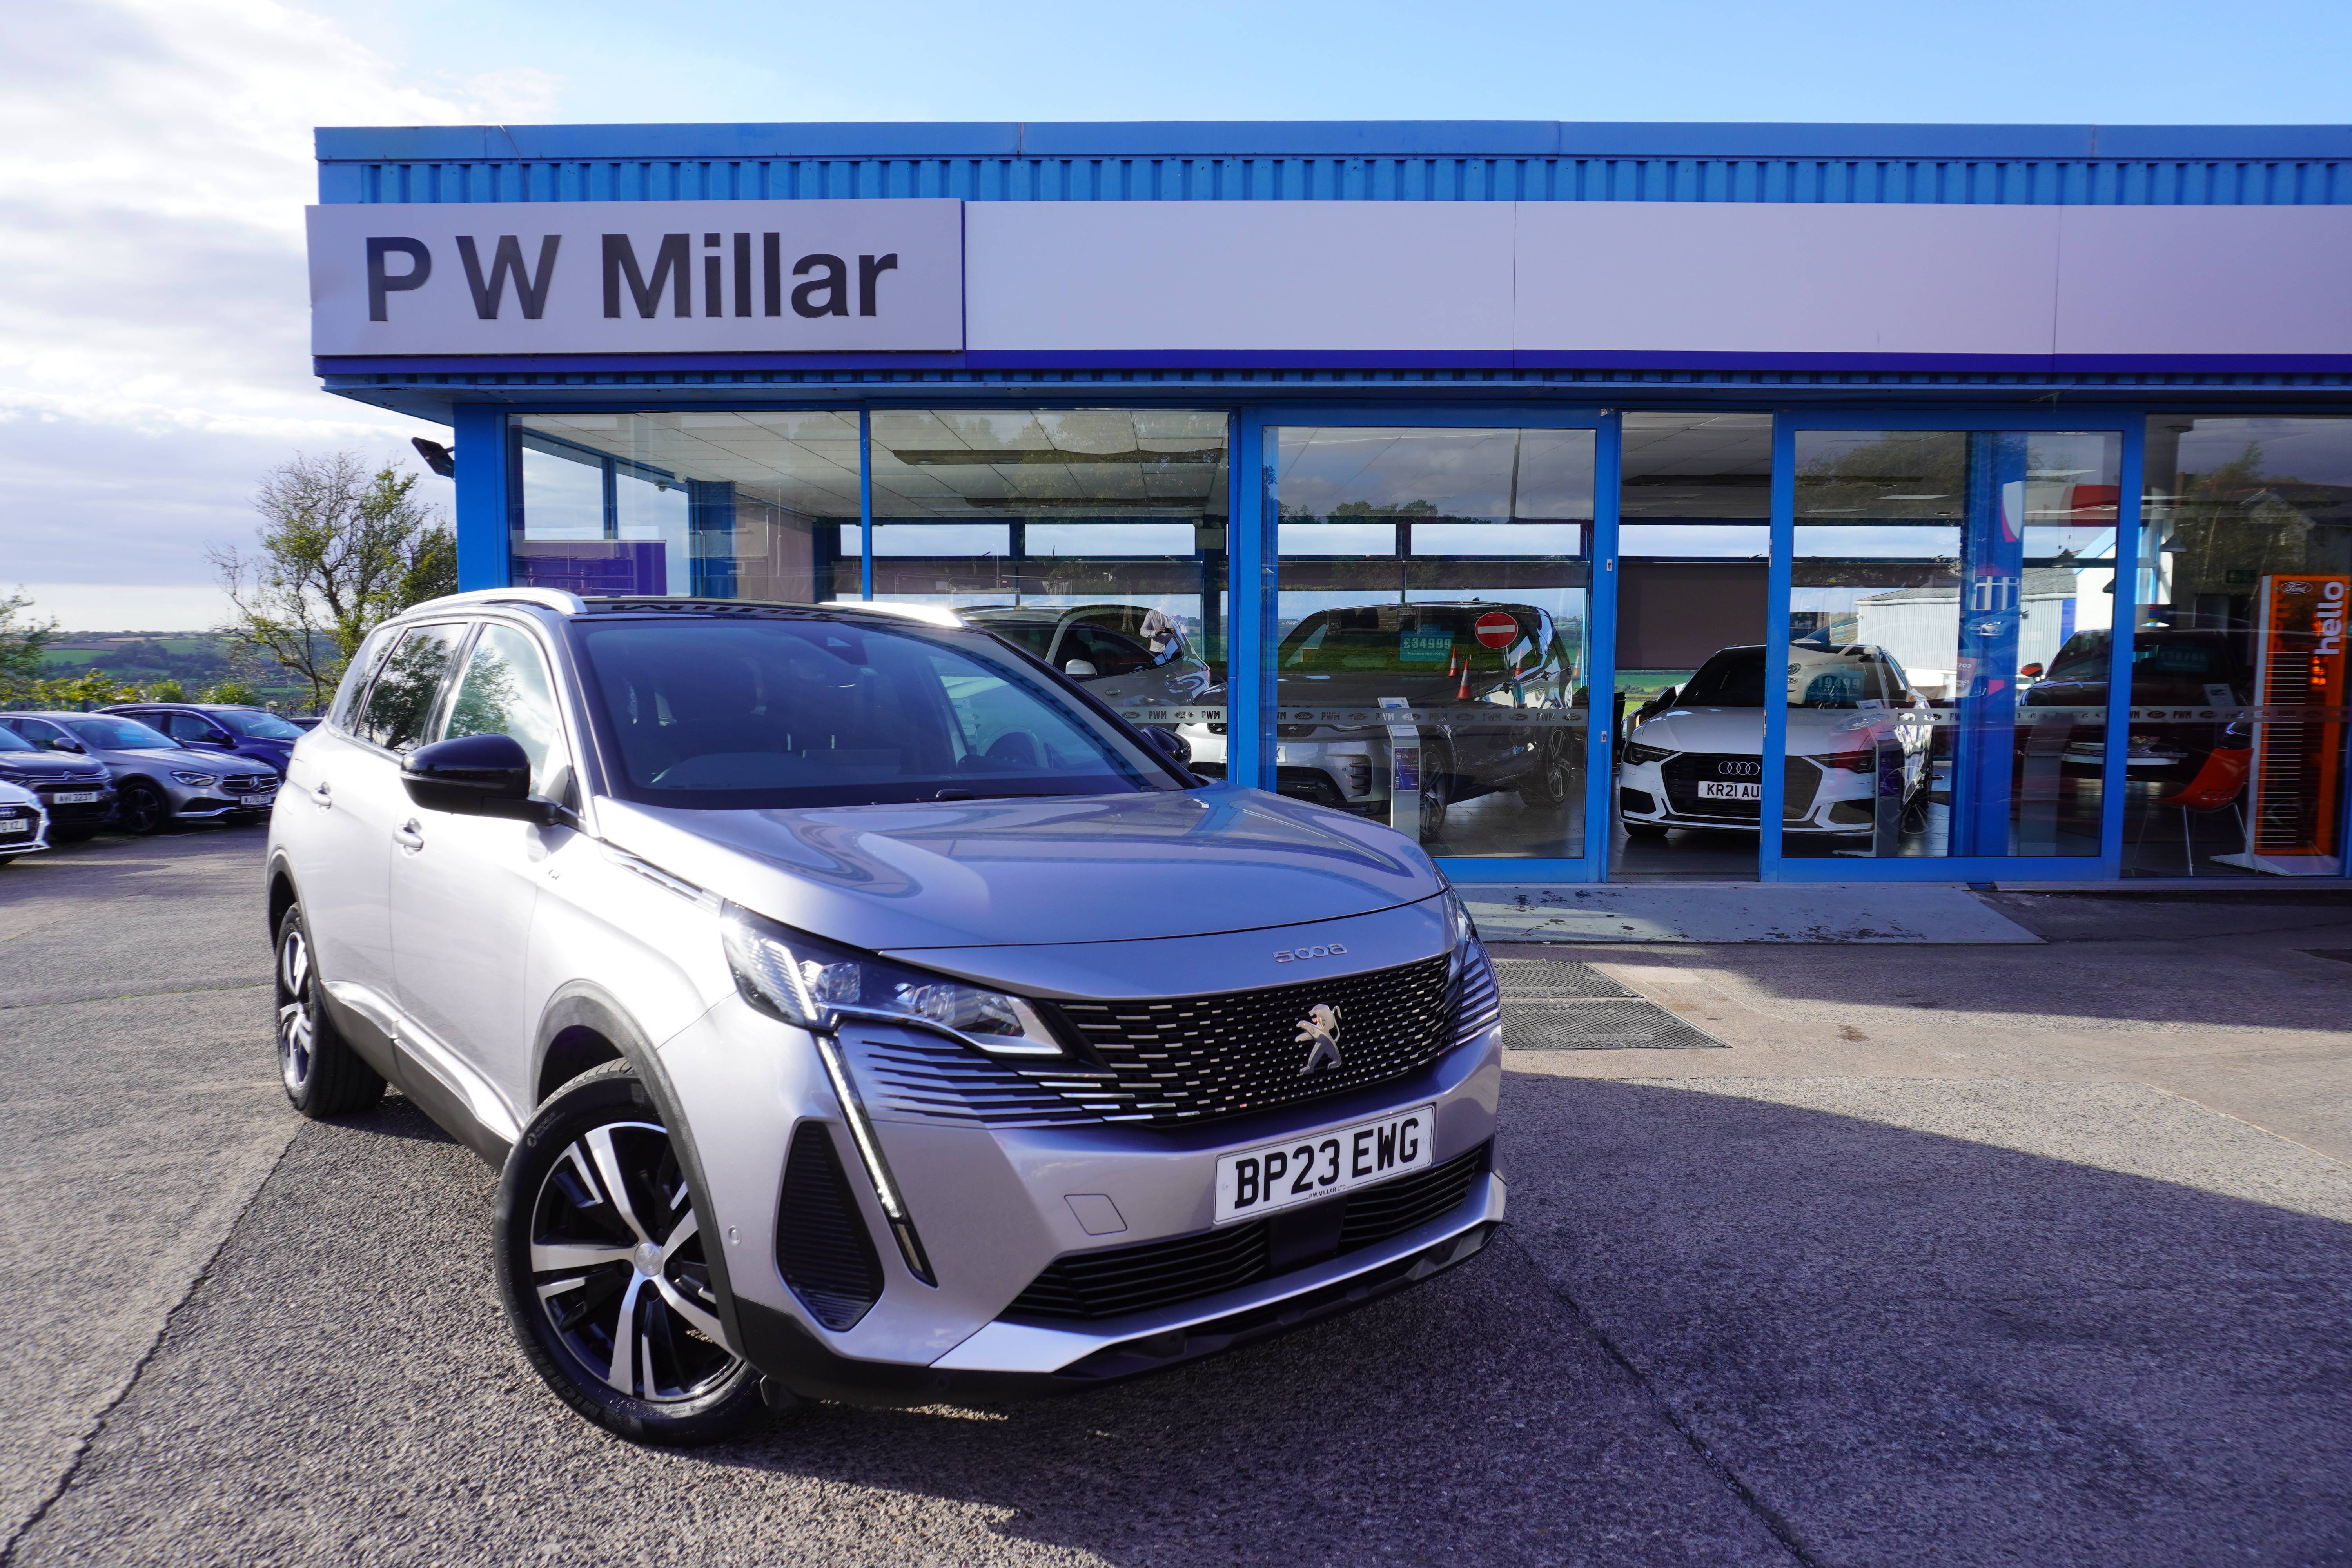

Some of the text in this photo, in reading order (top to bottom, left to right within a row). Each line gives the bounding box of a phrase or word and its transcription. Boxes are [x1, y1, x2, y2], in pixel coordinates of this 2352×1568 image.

[366, 232, 898, 322] P W Millar
[2286, 583, 2308, 592] Ford
[2314, 581, 2345, 654] hello
[1403, 637, 1452, 649] £34999
[1148, 711, 1167, 719] PWM
[1201, 711, 1220, 719] PWM
[1536, 713, 1555, 721] PWM
[2174, 710, 2192, 719] PWM
[1707, 783, 1760, 798] KR21 AU
[74, 793, 93, 801] 3237
[1273, 943, 1347, 963] 5008
[1234, 1118, 1419, 1209] BP23 EWG
